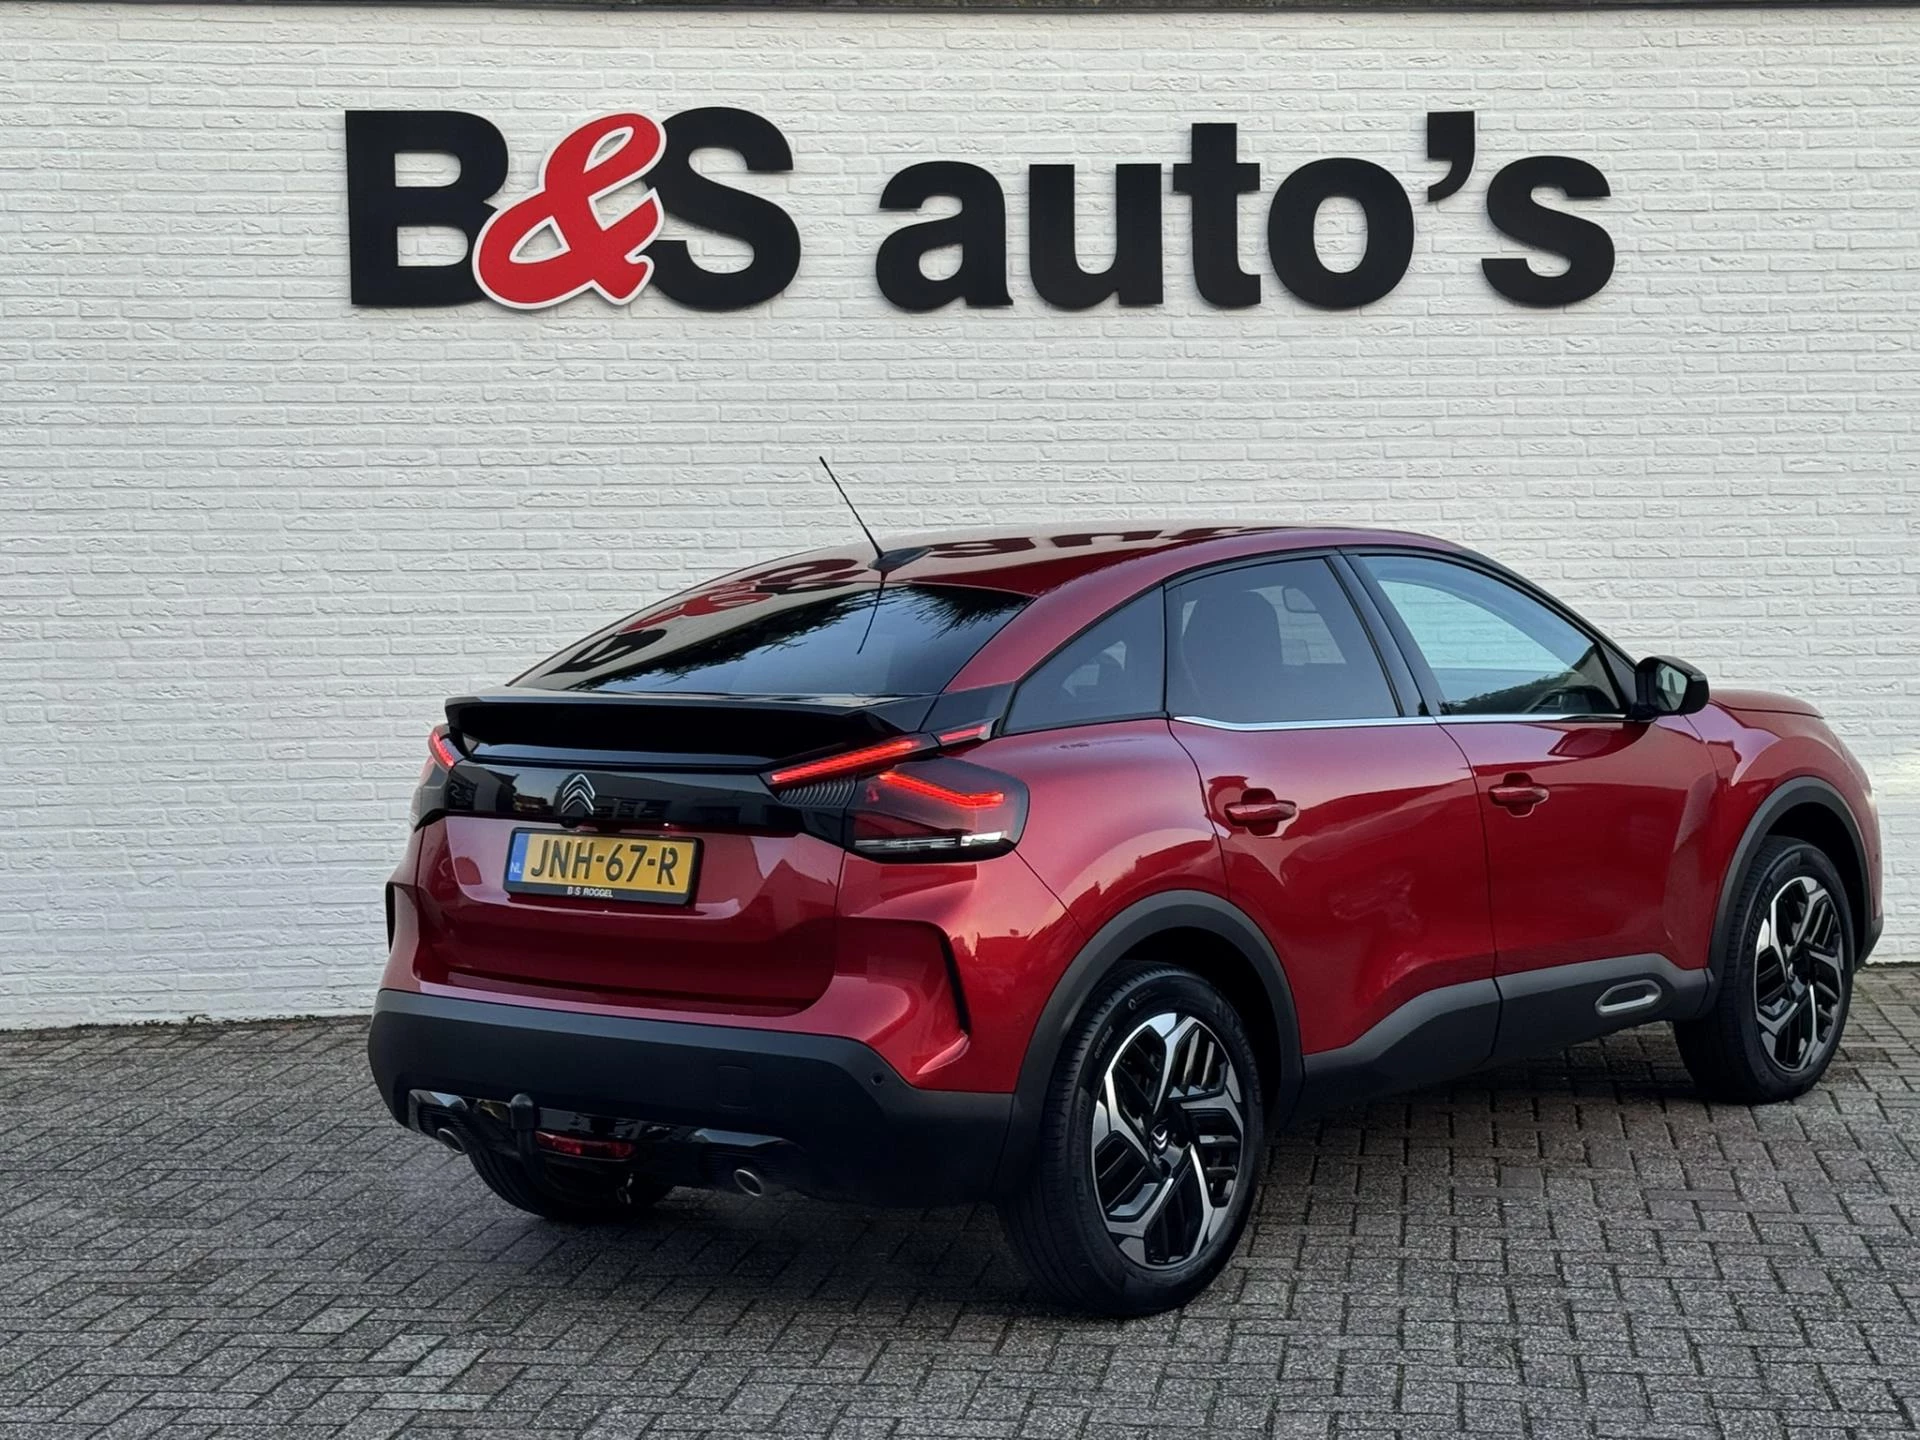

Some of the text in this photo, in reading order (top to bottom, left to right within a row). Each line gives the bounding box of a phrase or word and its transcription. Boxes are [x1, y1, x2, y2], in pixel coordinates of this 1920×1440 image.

[345, 106, 1617, 310] B&S auto's
[510, 862, 521, 873] NL
[531, 839, 678, 885] JNH-67-R
